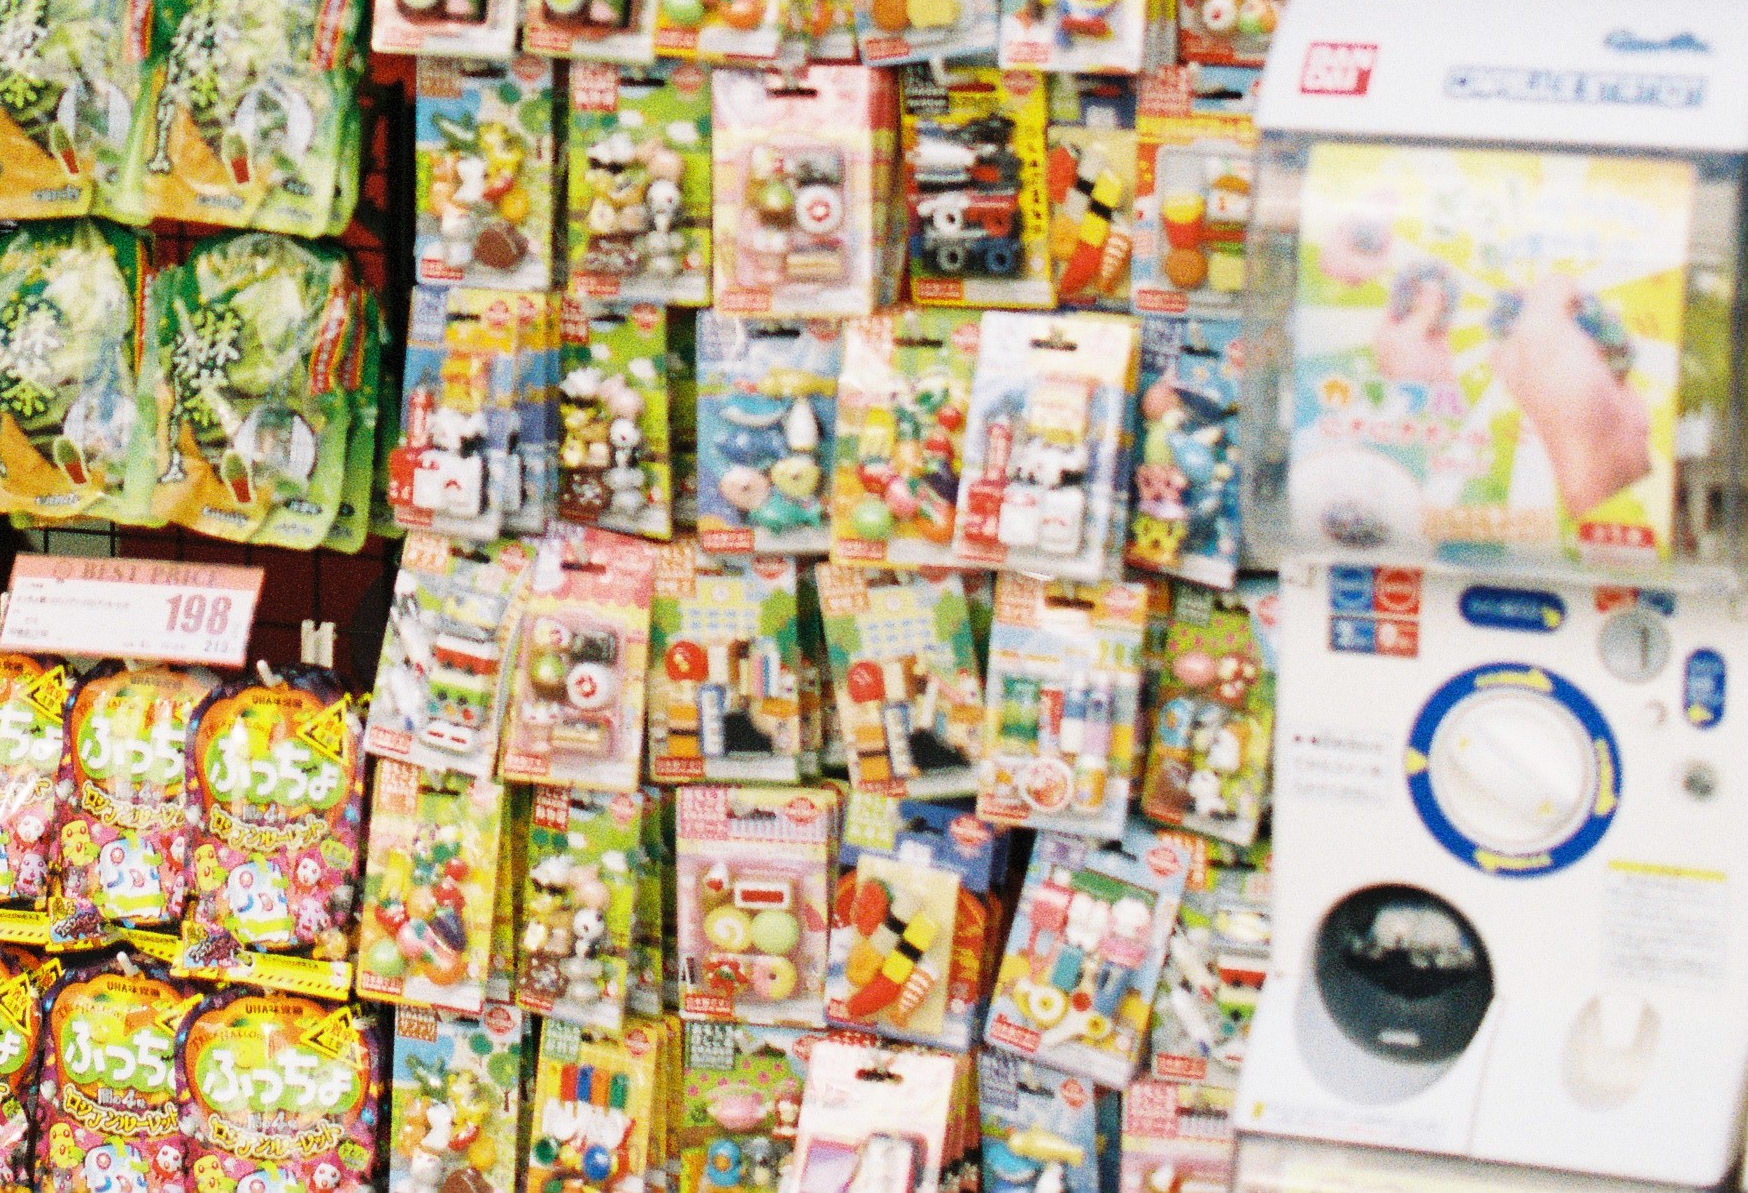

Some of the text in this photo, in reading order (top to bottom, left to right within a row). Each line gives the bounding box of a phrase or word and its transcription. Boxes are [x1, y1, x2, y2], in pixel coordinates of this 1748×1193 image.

[81, 561, 217, 588] BEST PRICE
[166, 592, 233, 637] 198
